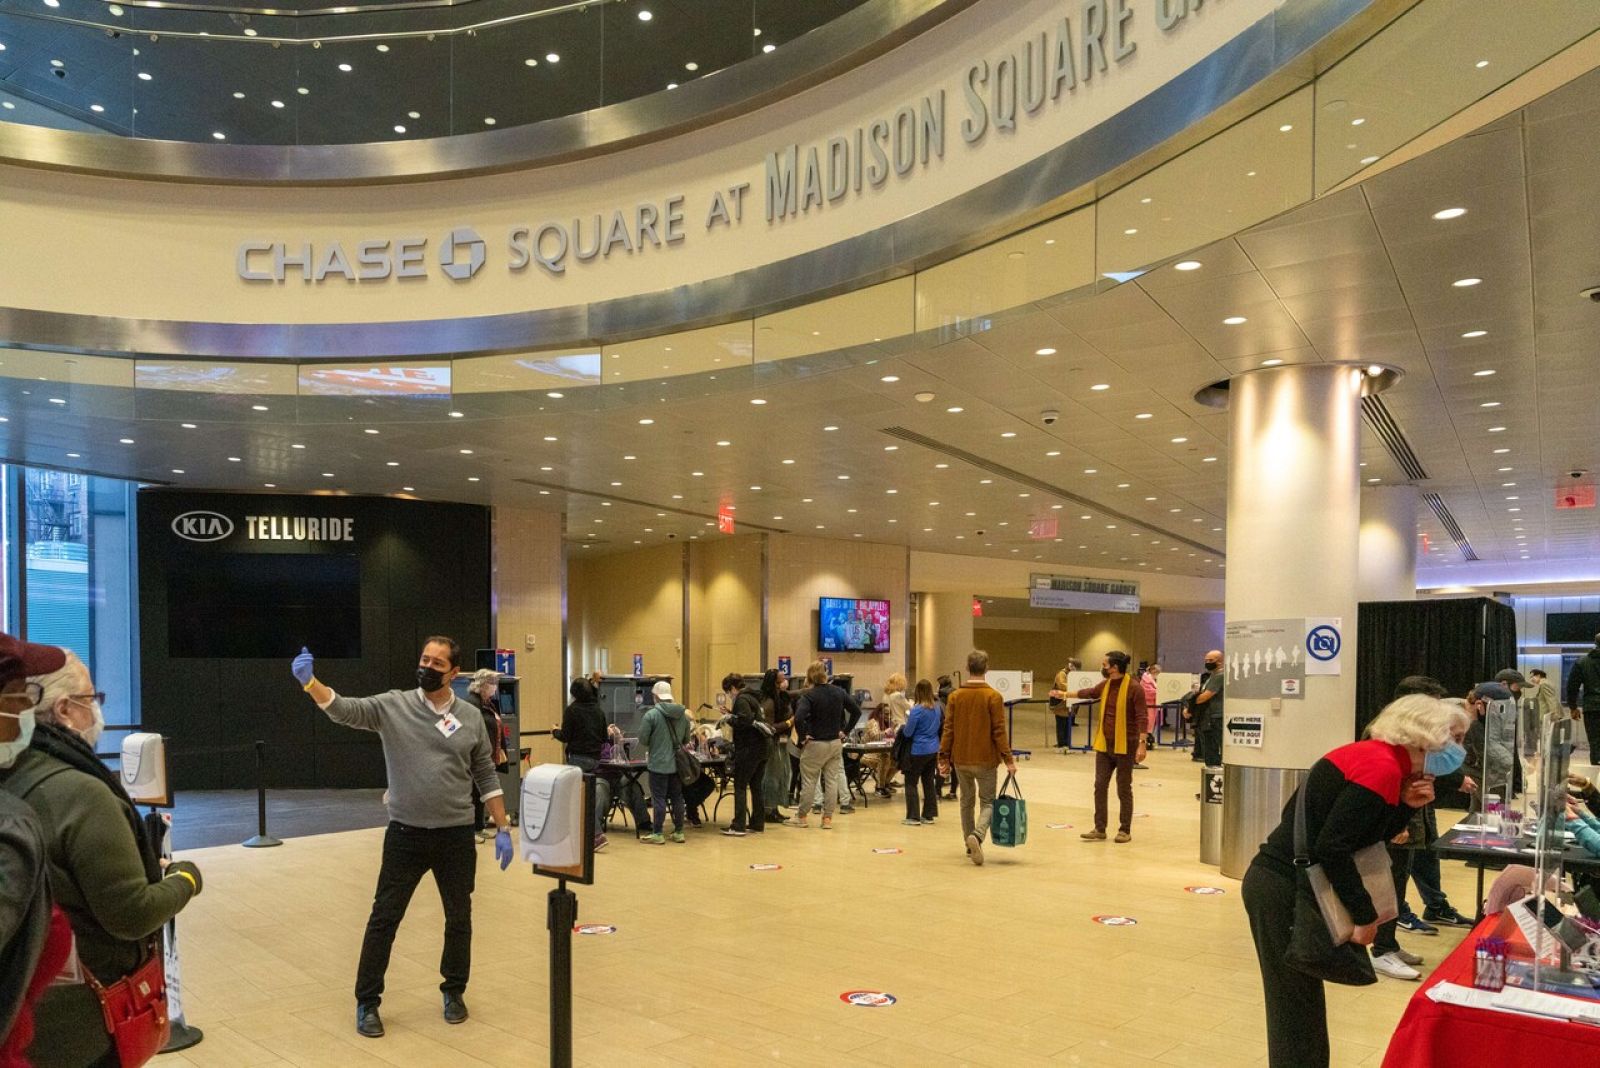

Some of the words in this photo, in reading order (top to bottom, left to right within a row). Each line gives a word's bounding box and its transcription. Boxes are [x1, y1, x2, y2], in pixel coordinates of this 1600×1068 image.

[237, 237, 428, 282] CHASE
[508, 194, 686, 273] SQUARE
[705, 182, 750, 230] AT
[764, 88, 946, 223] MADISON
[961, 0, 1137, 143] SQUARE
[245, 515, 355, 541] TELLURIDE
[502, 660, 509, 674] 1
[635, 664, 641, 675] 2
[782, 664, 788, 675] 3
